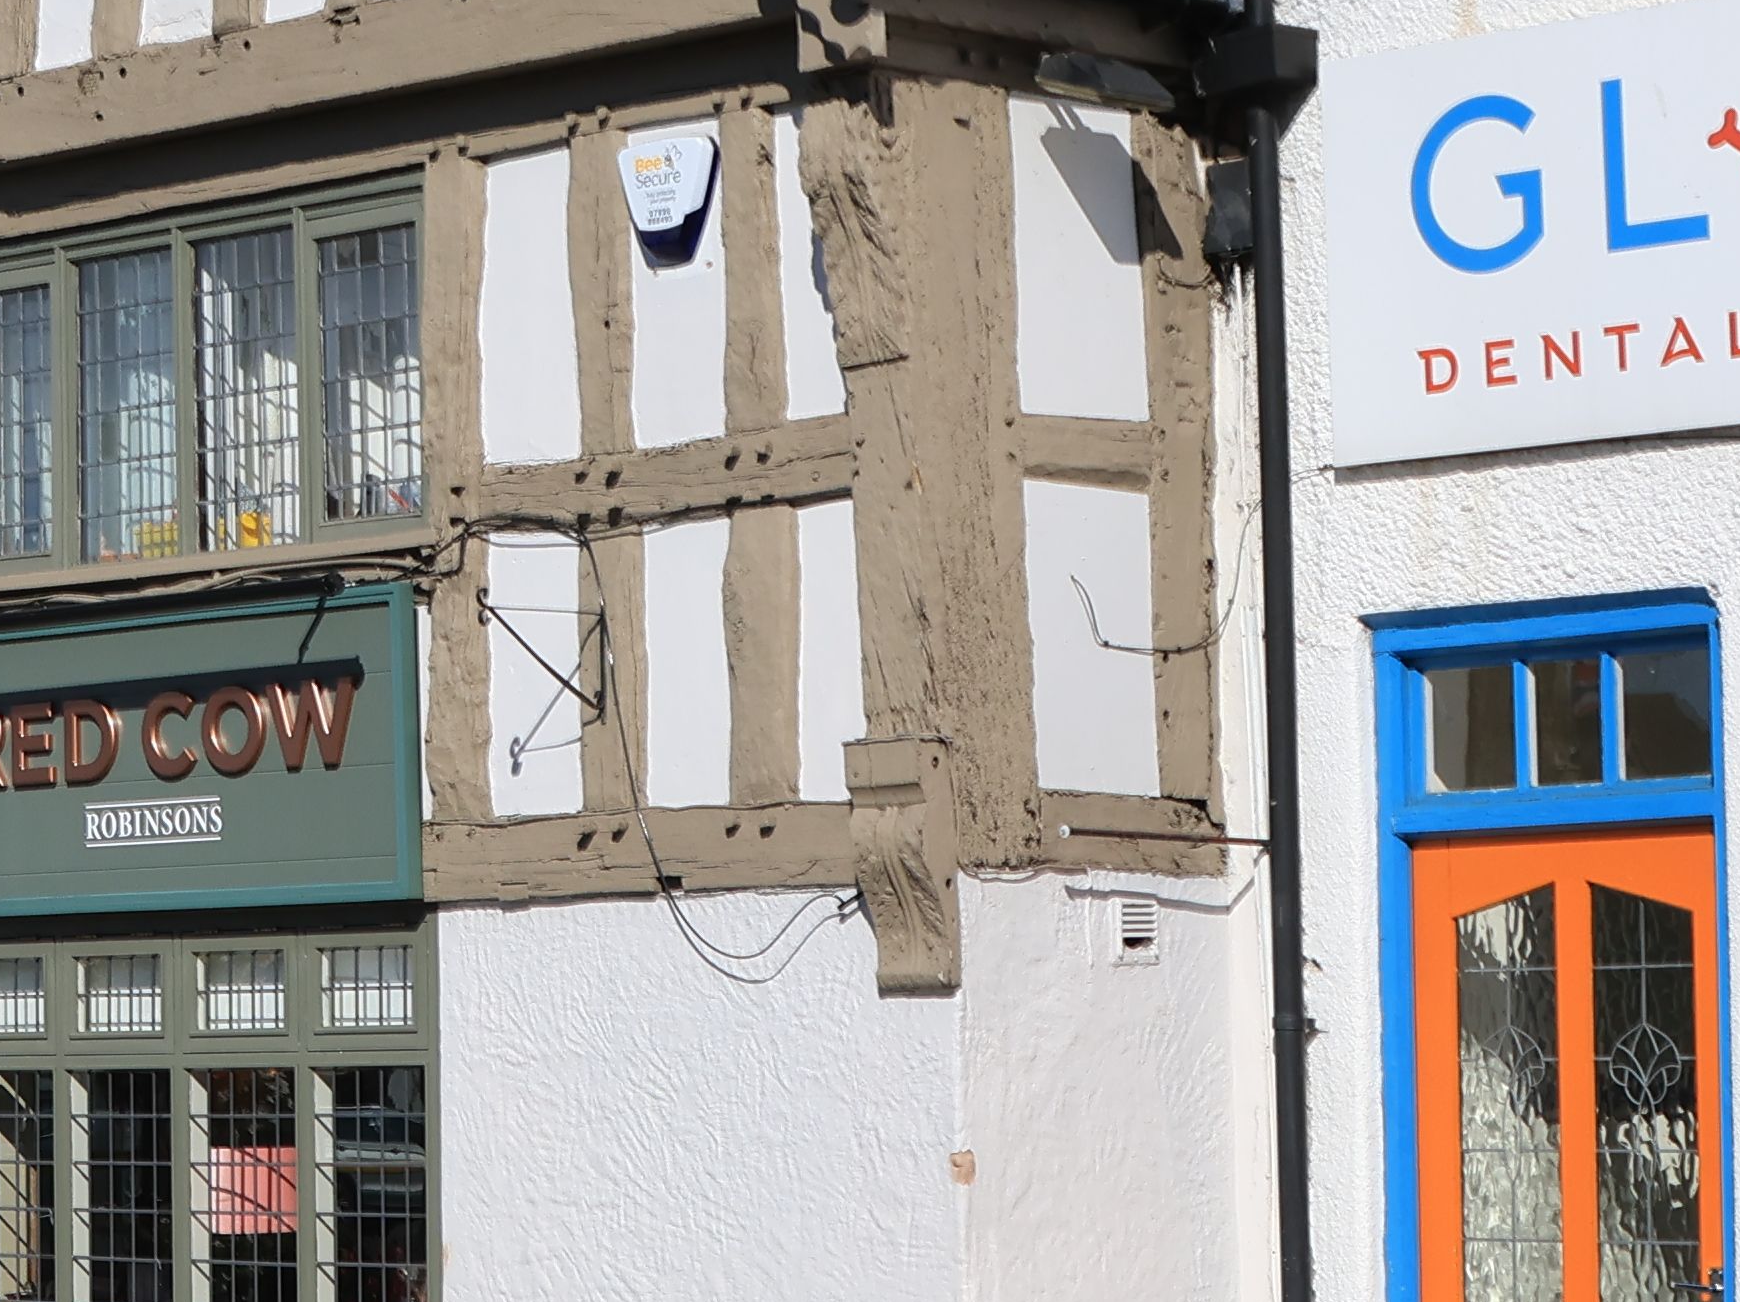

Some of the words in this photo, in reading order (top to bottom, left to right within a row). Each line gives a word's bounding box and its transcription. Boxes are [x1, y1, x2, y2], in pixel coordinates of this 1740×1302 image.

[634, 155, 663, 173] Bee
[635, 171, 681, 189] Secure
[140, 677, 358, 783] COW
[86, 805, 223, 840] ROBINSONS
